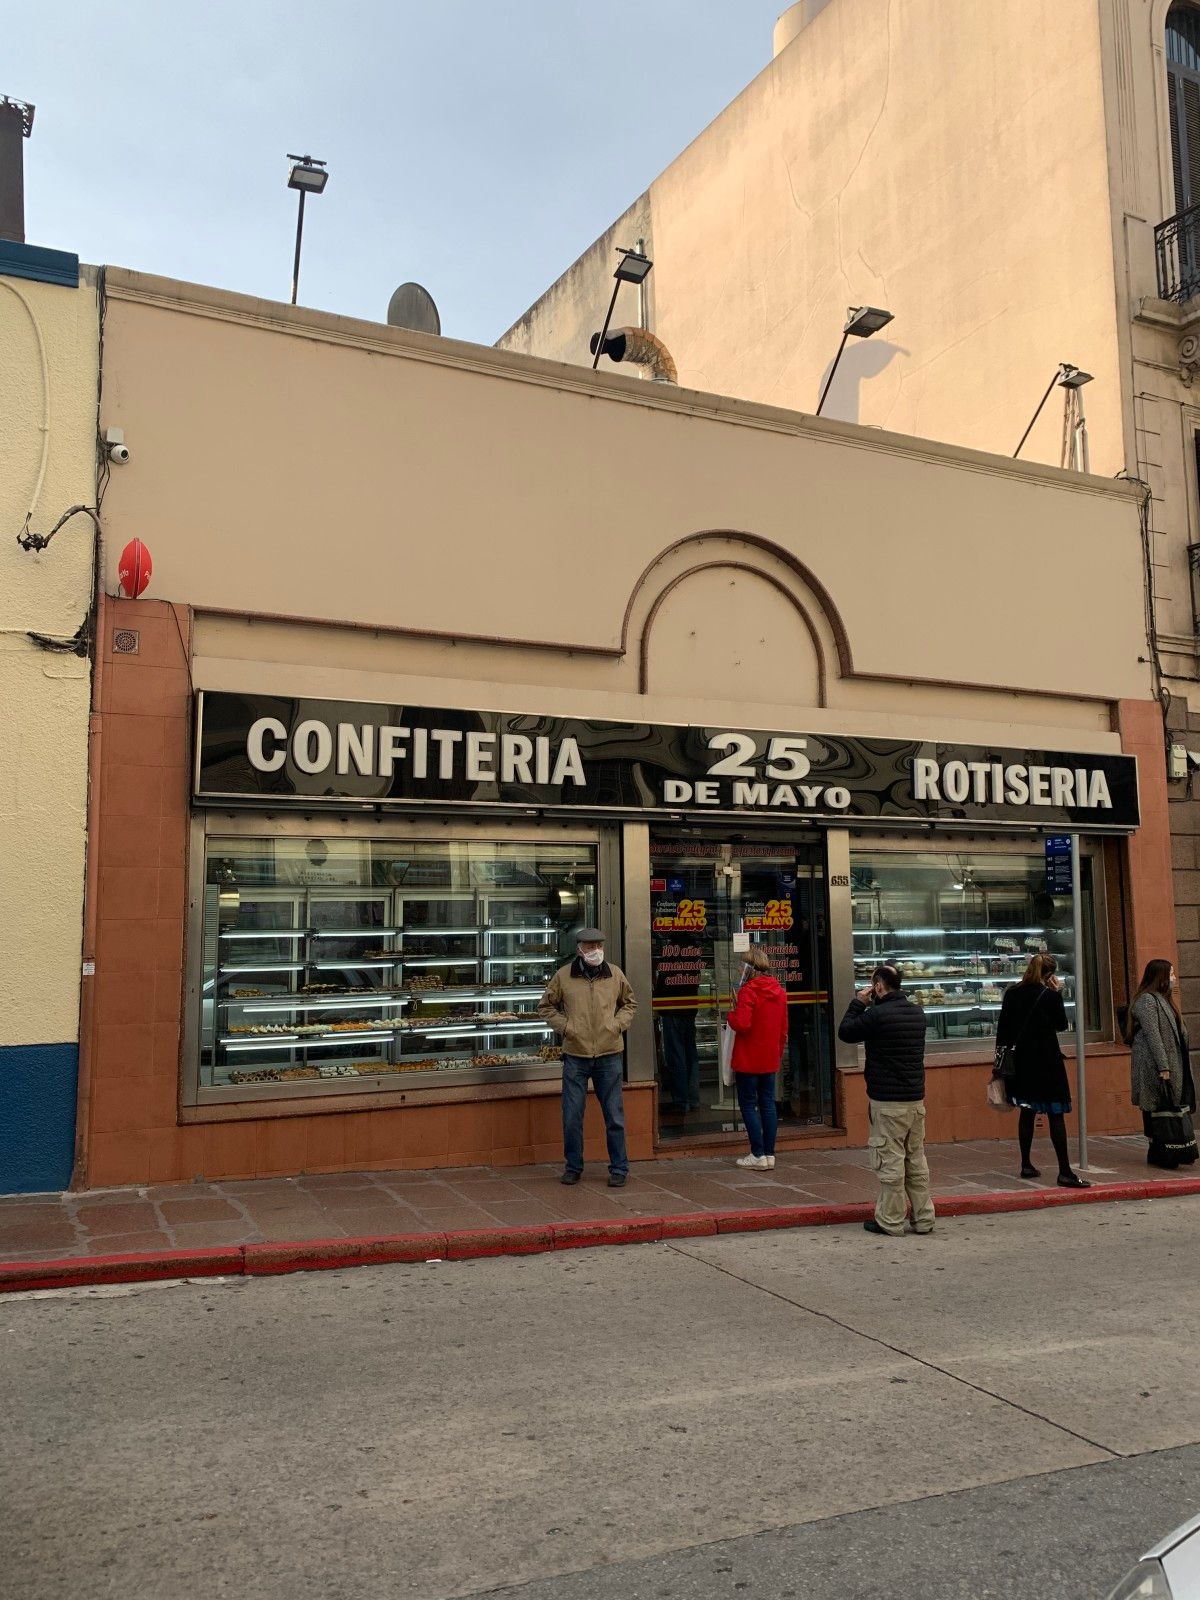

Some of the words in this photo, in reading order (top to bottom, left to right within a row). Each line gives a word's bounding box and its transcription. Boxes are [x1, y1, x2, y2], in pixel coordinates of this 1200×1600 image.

[247, 716, 587, 787] CONFITERIA
[706, 733, 811, 781] 25
[913, 758, 1112, 809] ROTISERIA
[664, 780, 720, 804] DE
[733, 783, 851, 809] MAYO
[831, 875, 849, 887] 655
[678, 899, 706, 917] 25
[767, 899, 793, 917] 25
[656, 917, 673, 927] DE
[674, 917, 707, 927] MAYO
[745, 916, 762, 926] DE
[763, 916, 794, 926] MAYO
